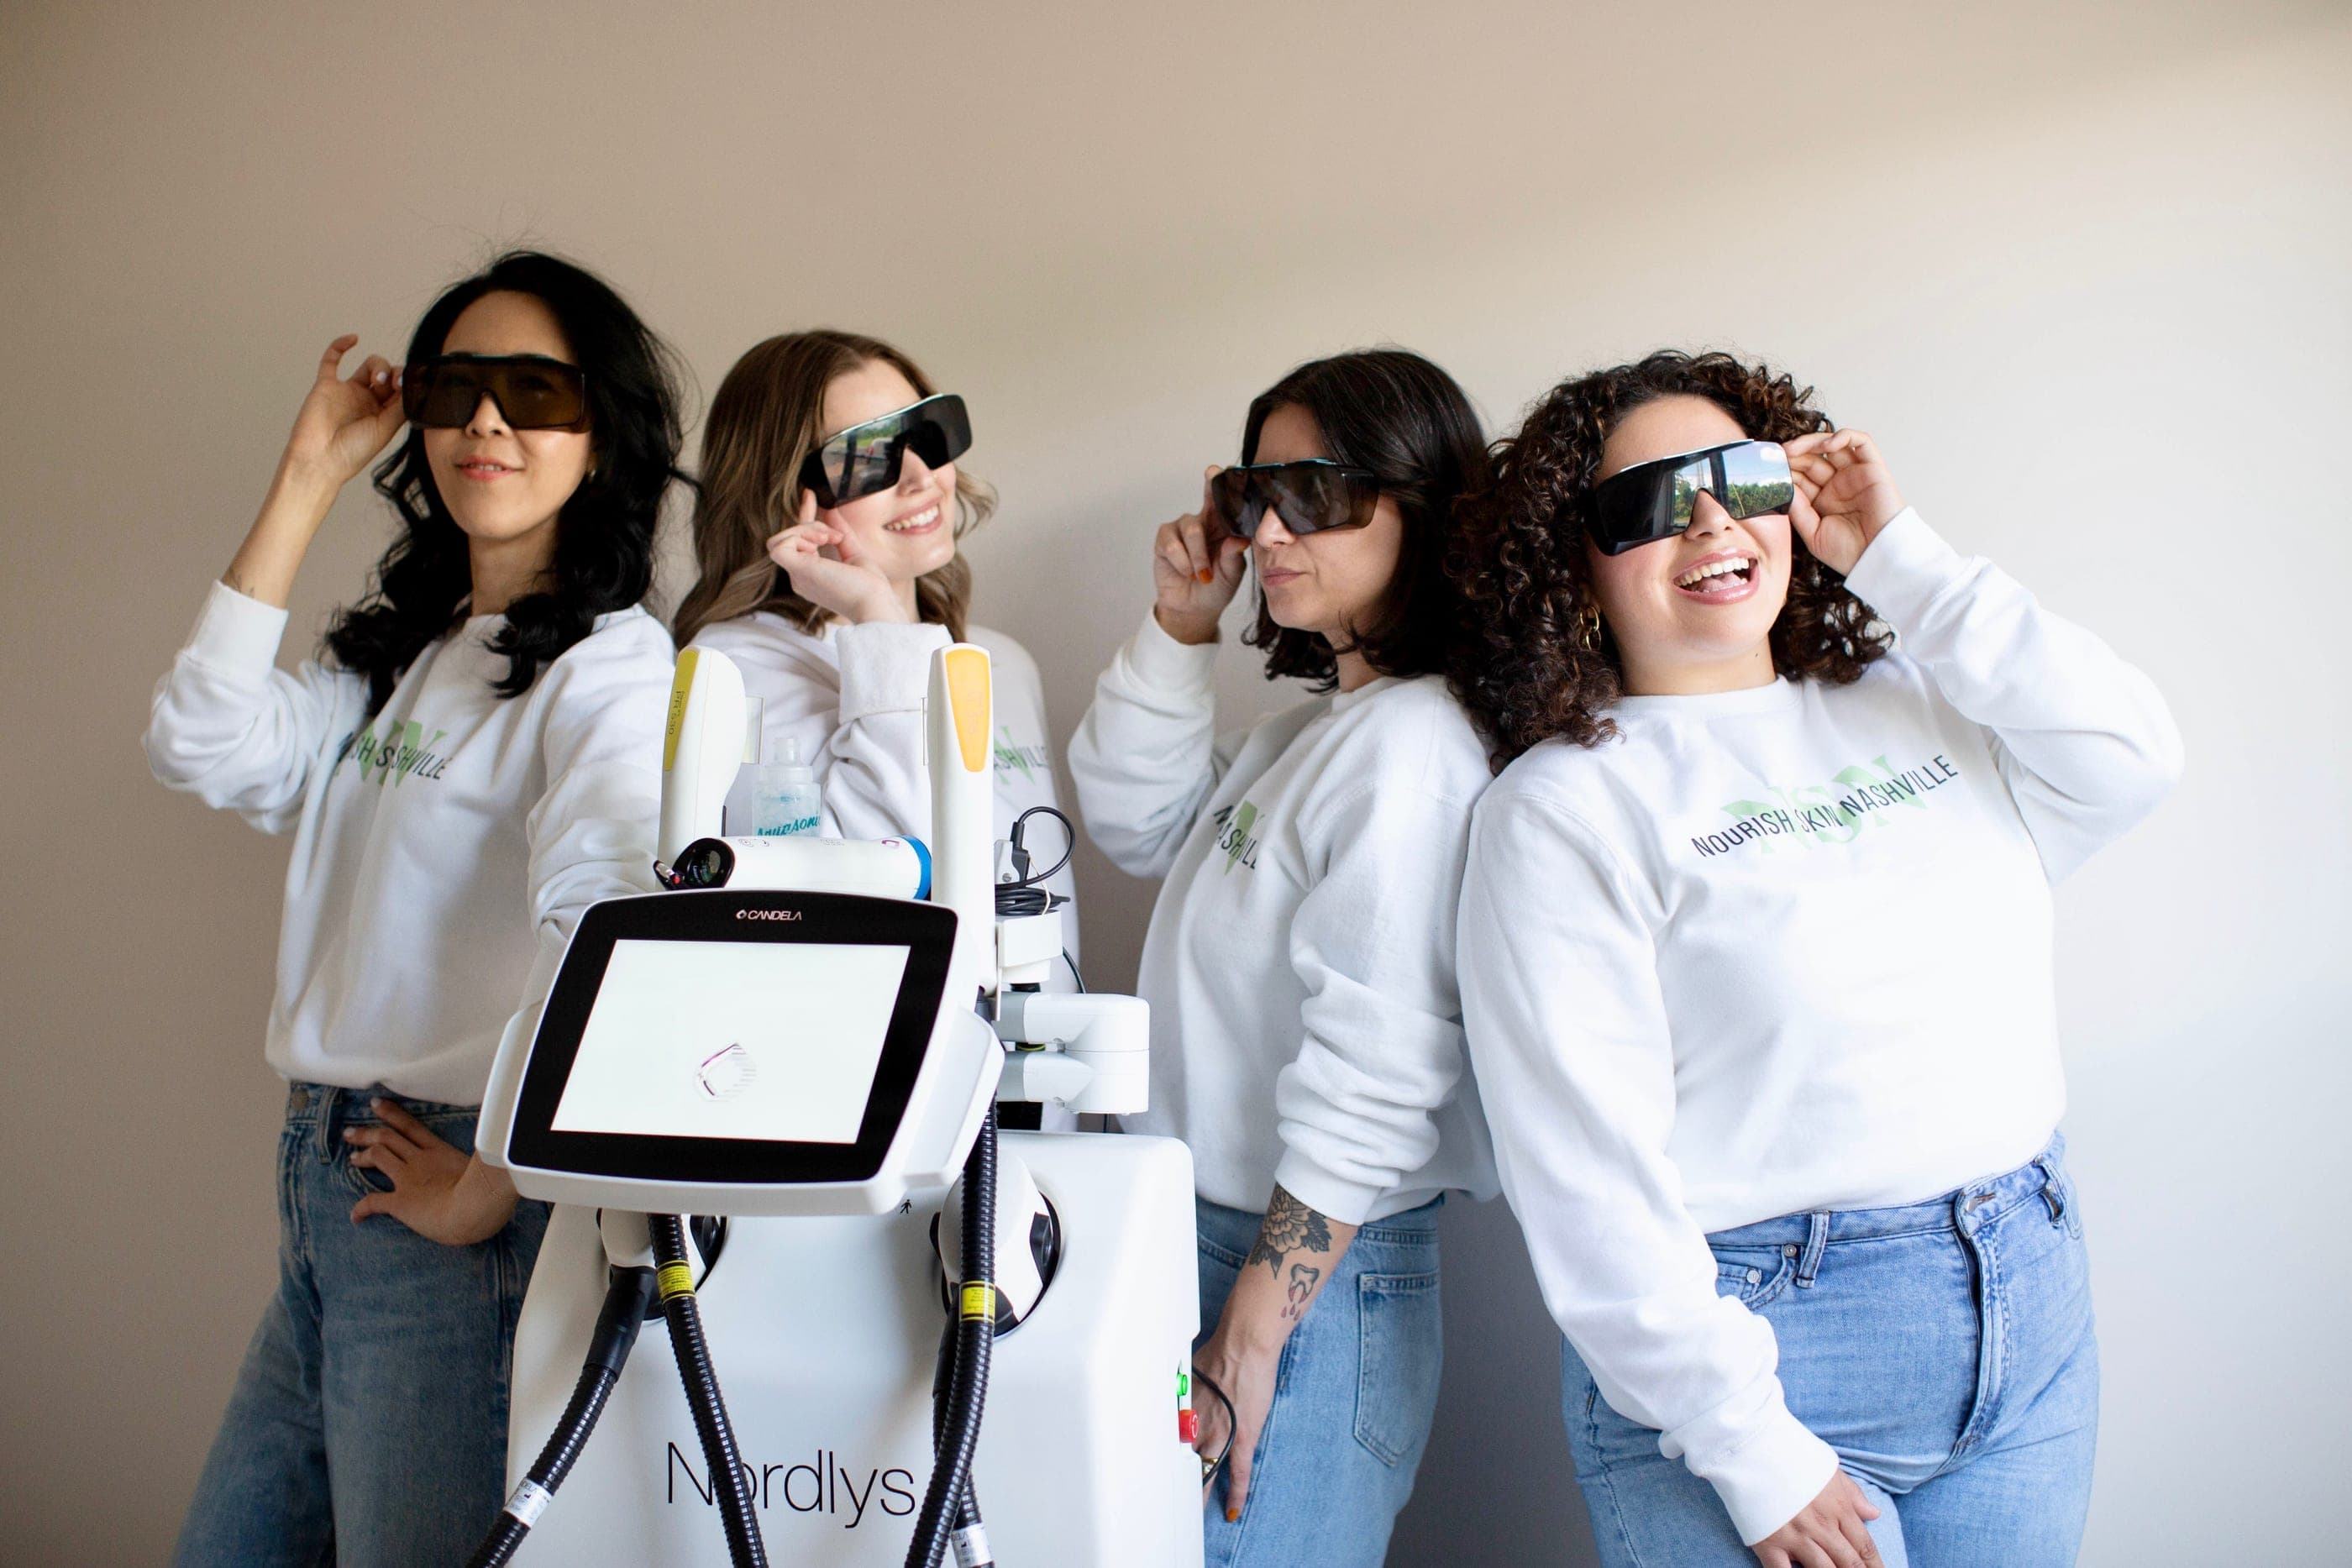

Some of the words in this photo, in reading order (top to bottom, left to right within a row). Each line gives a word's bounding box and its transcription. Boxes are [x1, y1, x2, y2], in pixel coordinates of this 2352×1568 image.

[1690, 809, 1795, 857] NOURISH
[1794, 804, 1844, 833] SKIN
[1839, 754, 1959, 818] NASHVILLE
[748, 910, 802, 920] CANDELA
